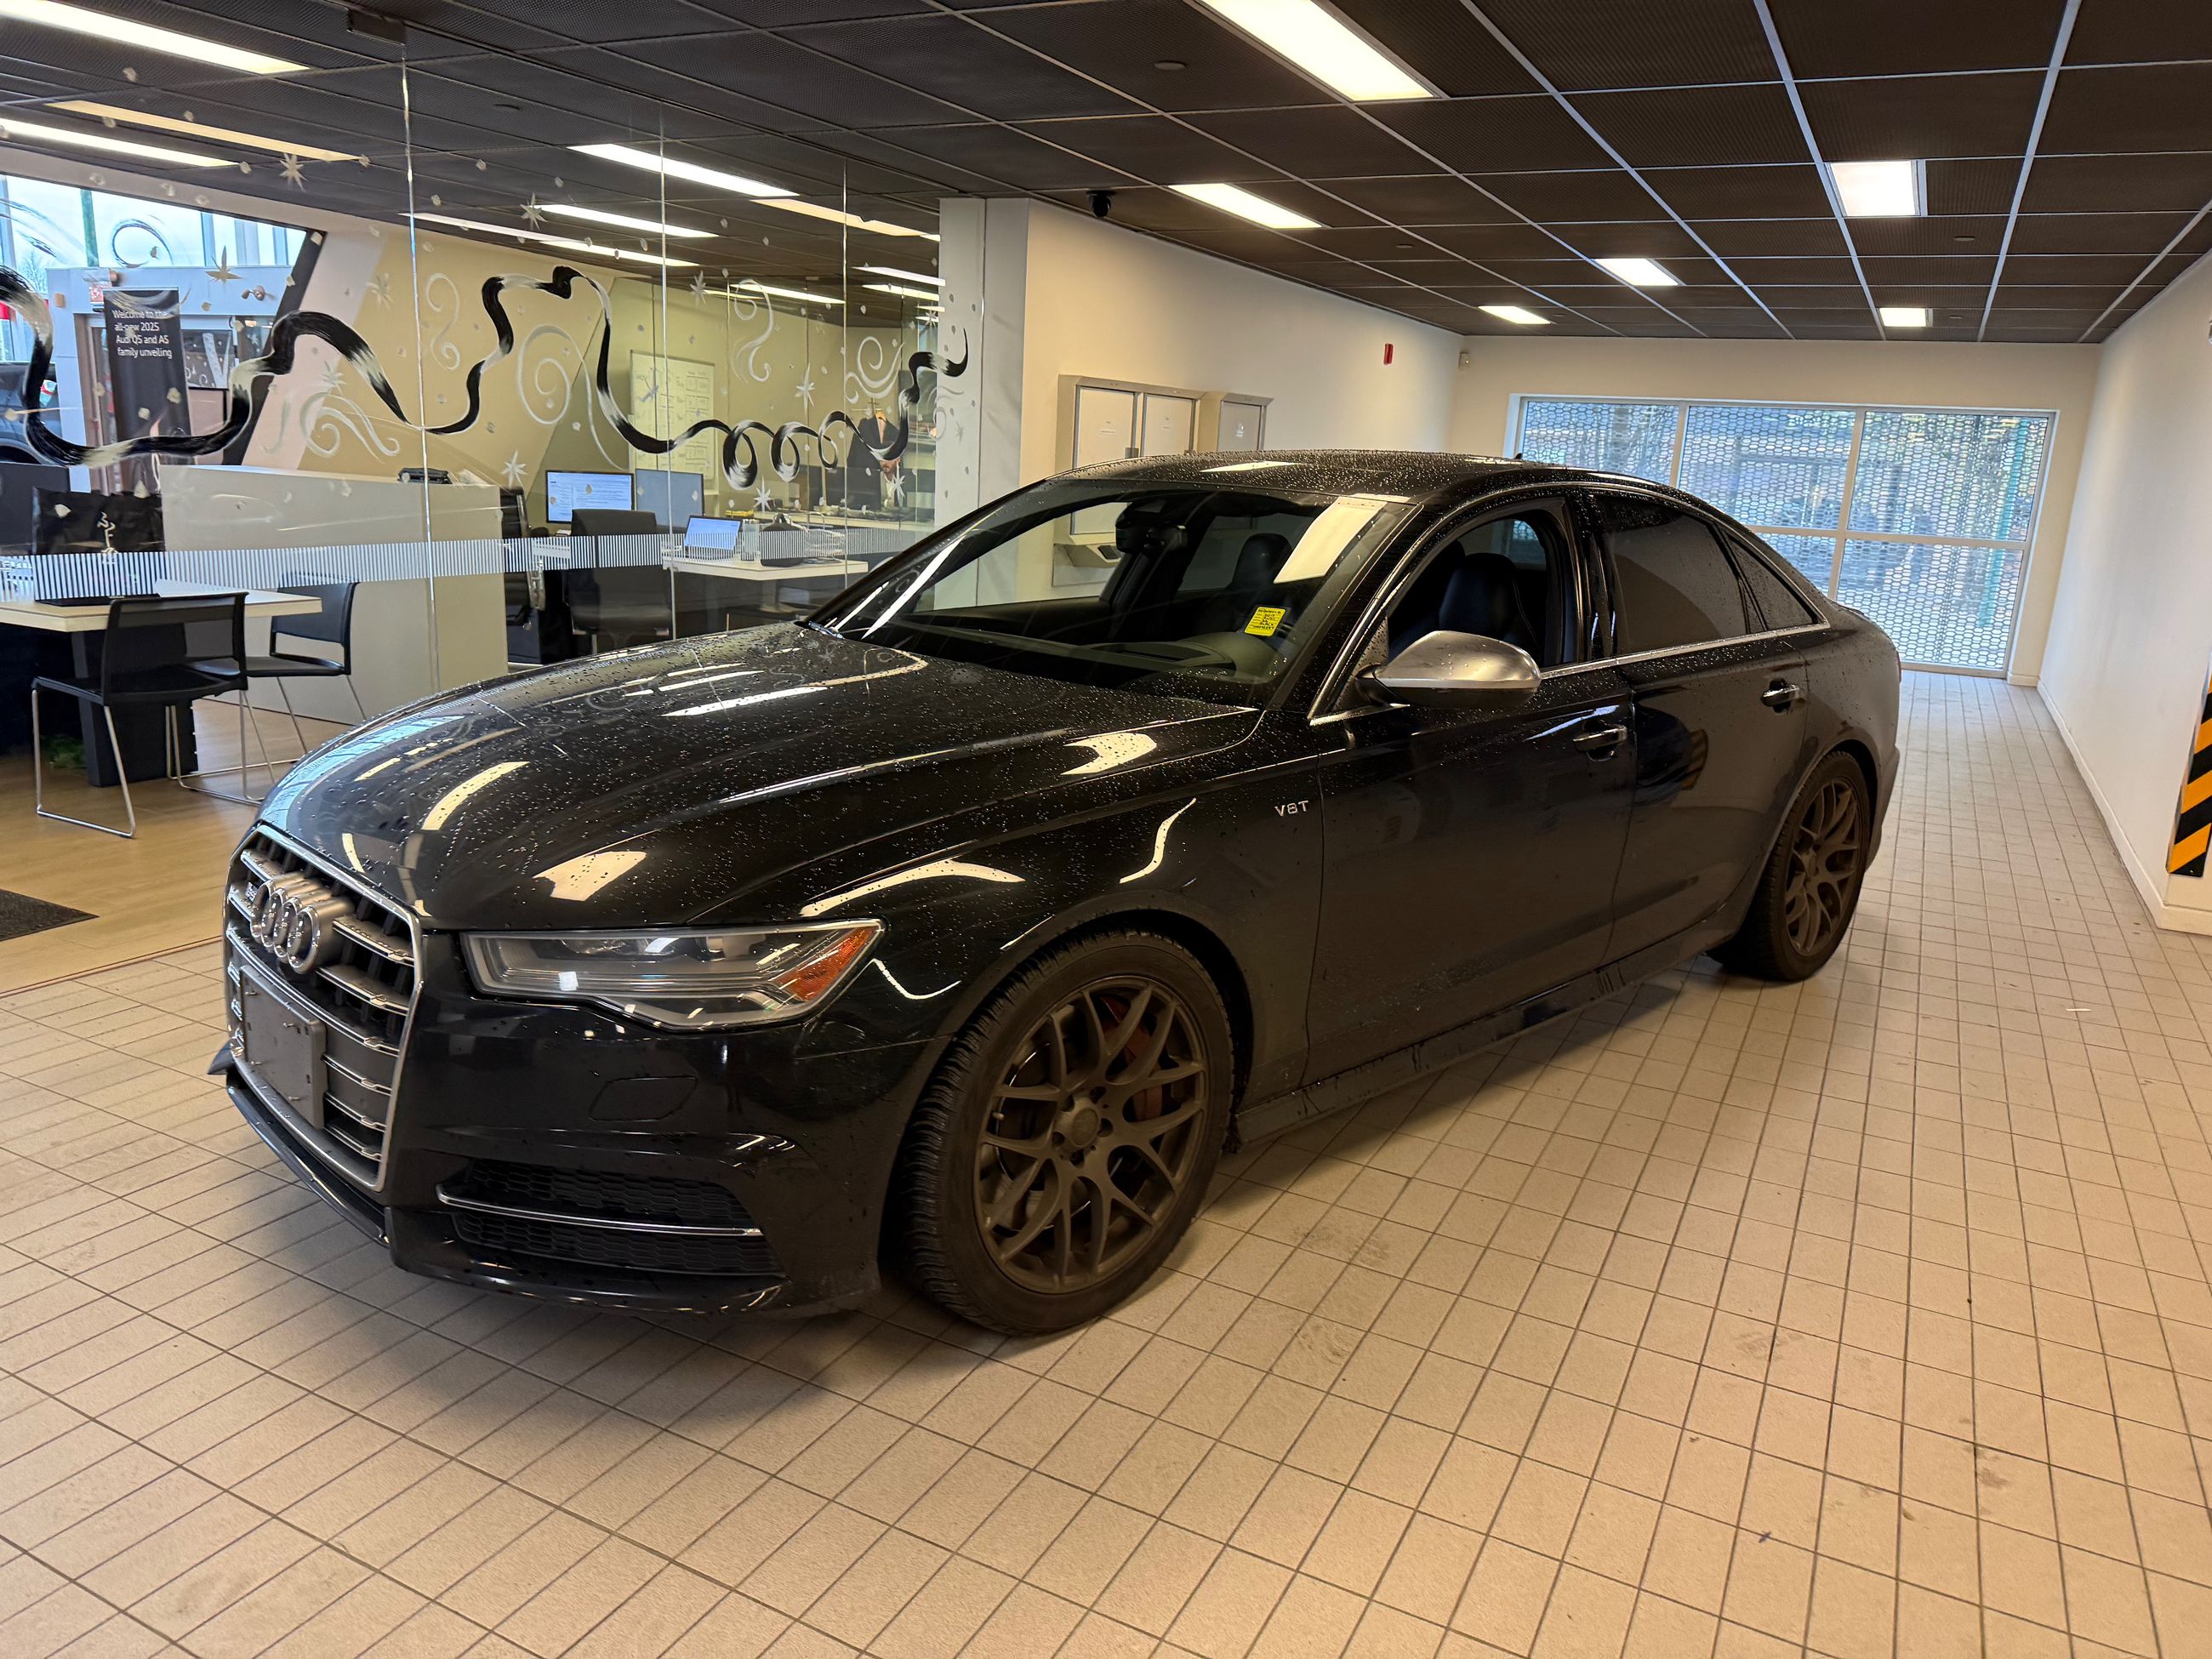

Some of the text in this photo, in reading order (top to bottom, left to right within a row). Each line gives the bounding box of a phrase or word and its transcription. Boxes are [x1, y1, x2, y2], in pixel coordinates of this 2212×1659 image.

[112, 310, 145, 319] Welcome
[145, 311, 154, 319] to
[140, 322, 160, 331] 2025
[116, 334, 170, 345] Audi Q5 and A5
[117, 347, 173, 359] family unveiling
